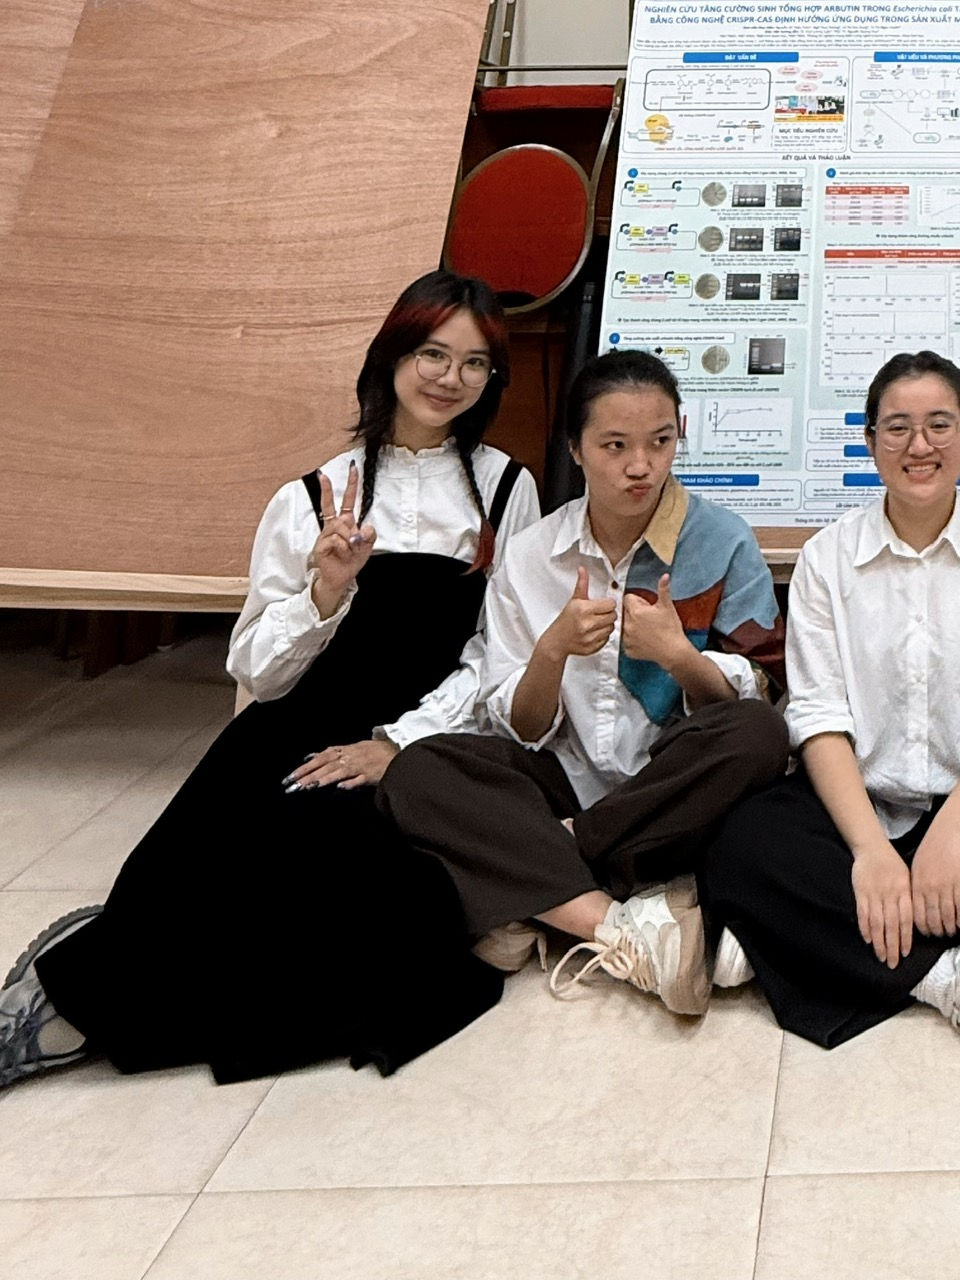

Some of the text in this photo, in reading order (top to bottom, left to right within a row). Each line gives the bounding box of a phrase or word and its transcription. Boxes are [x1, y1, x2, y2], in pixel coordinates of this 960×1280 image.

[644, 4, 677, 13] NGHIÊN
[700, 4, 722, 13] TĂNG
[757, 5, 776, 13] SINH
[779, 3, 802, 13] TỔNG
[804, 5, 822, 14] HỢP
[824, 5, 860, 13] ARBUTIN
[893, 5, 937, 13] Escherichia
[939, 5, 953, 13] coli
[650, 15, 673, 24] BẰNG
[676, 14, 699, 24] CÔNG
[701, 14, 725, 25] NGHỆ
[726, 16, 773, 24] CRISPR-CAS
[775, 15, 796, 25] ĐỊNH
[797, 14, 830, 23] HƯỚNG
[854, 15, 878, 25] DỤNG
[880, 15, 909, 23] TRONG
[911, 13, 928, 23] SẢN
[930, 13, 952, 23] XUẤT
